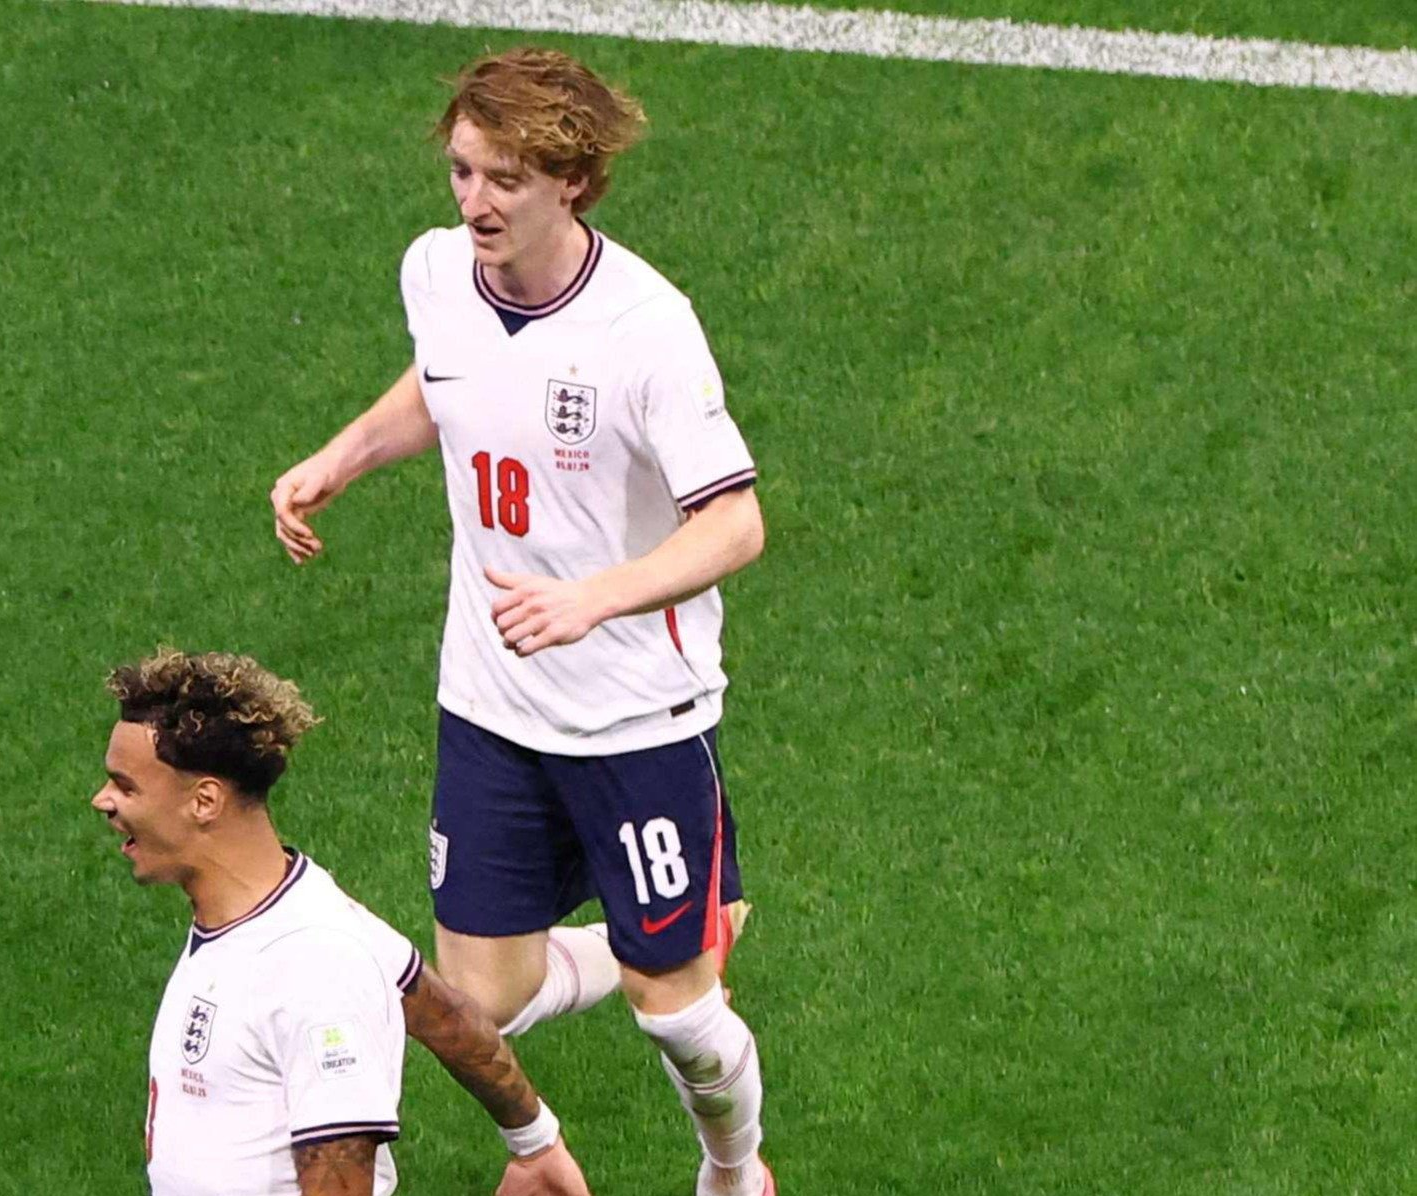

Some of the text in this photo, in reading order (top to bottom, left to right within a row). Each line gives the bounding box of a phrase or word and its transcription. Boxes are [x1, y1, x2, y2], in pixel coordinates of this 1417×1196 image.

[471, 450, 531, 538] 18
[554, 448, 589, 459] MEXICO
[618, 816, 690, 905] 18
